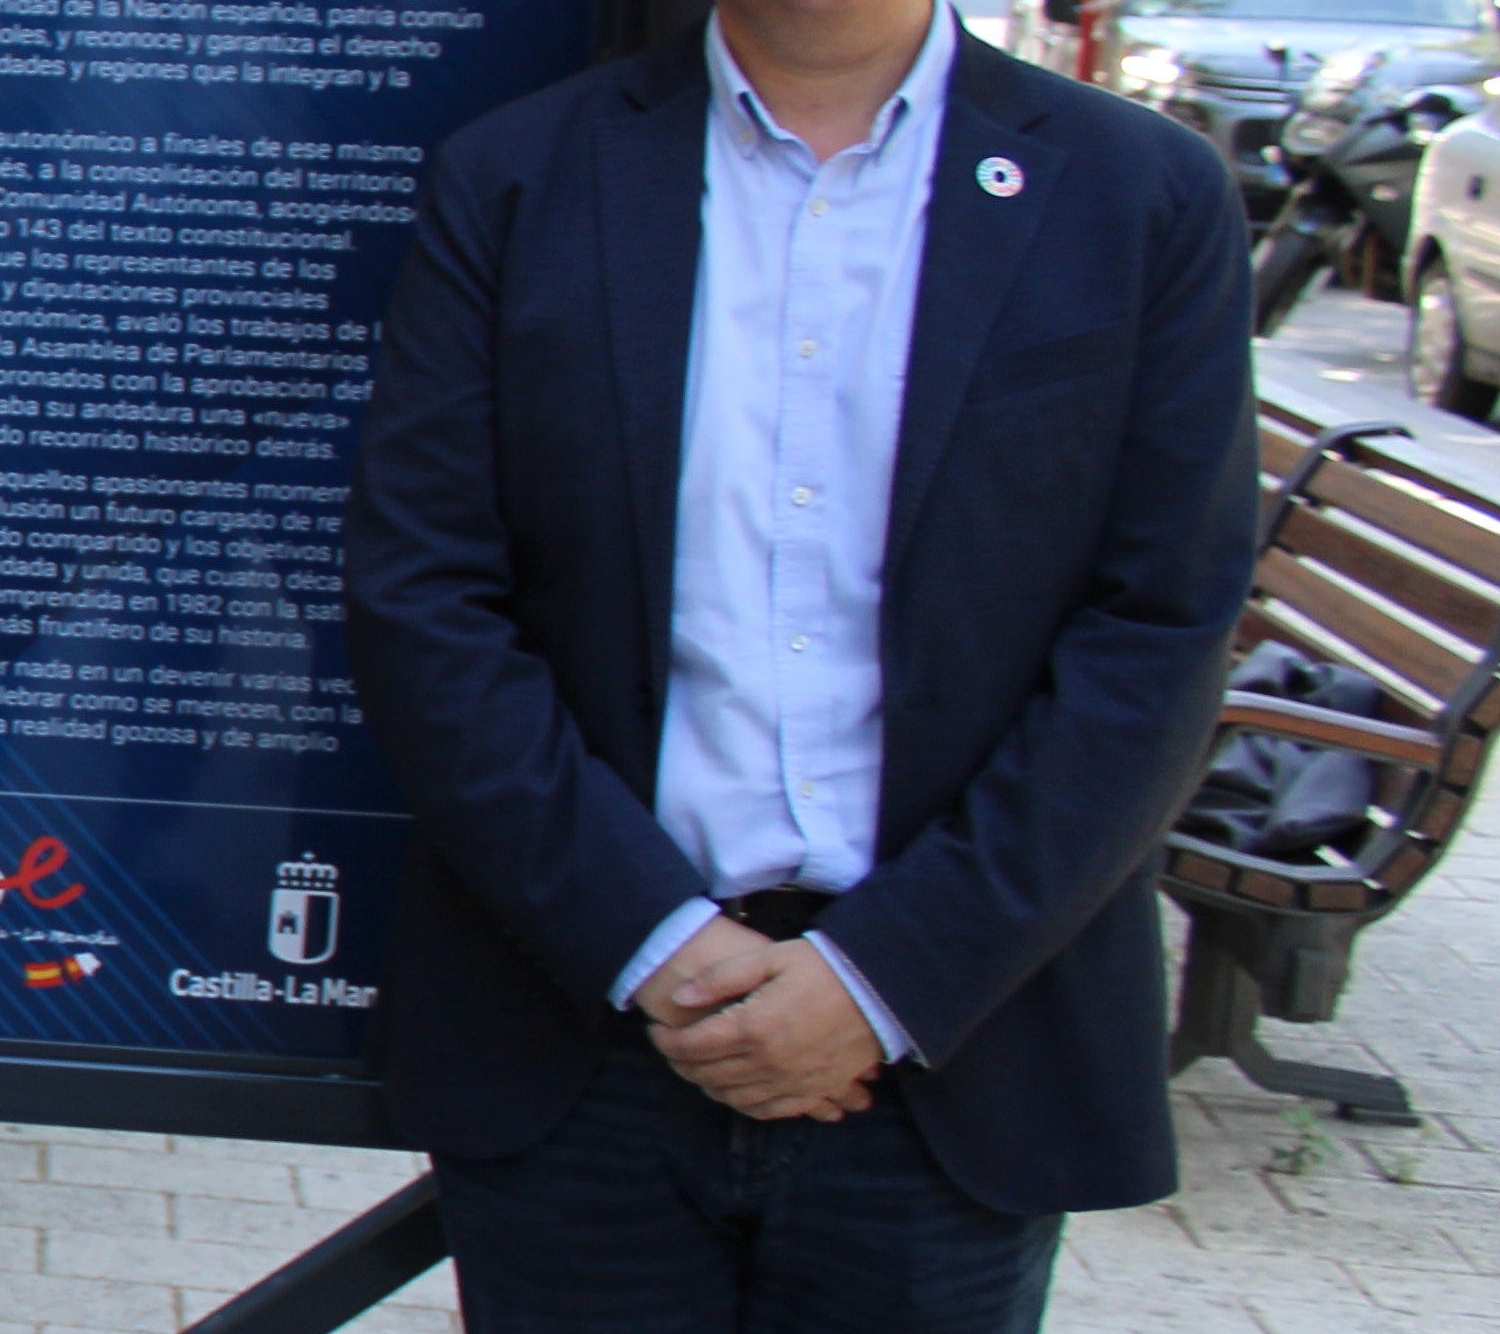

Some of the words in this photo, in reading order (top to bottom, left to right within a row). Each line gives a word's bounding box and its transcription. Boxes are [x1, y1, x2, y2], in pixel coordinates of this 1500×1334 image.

[139, 136, 158, 153] a
[162, 132, 246, 157] finales
[250, 135, 284, 158] de
[285, 141, 333, 160] ese
[336, 138, 424, 163] mismo
[37, 162, 56, 180] a
[60, 158, 84, 181] la
[263, 166, 303, 189] del
[306, 167, 416, 193] territorio
[16, 216, 63, 240] 143
[66, 218, 106, 241] del
[110, 219, 174, 244] texto
[1, 280, 18, 301] y
[20, 275, 178, 308] diputaciones
[181, 282, 330, 314] provinciales
[20, 335, 142, 362] Asamblea
[145, 340, 179, 363] de
[182, 341, 369, 371] Parlamentarios
[28, 424, 139, 450] recorrido
[148, 619, 180, 643] de
[183, 626, 214, 645] su
[12, 713, 107, 740] realidad
[110, 724, 198, 749] gozosa
[202, 729, 217, 750] y
[221, 725, 254, 748] de
[257, 727, 339, 757] amplio
[168, 968, 320, 1005] Castilla-La
